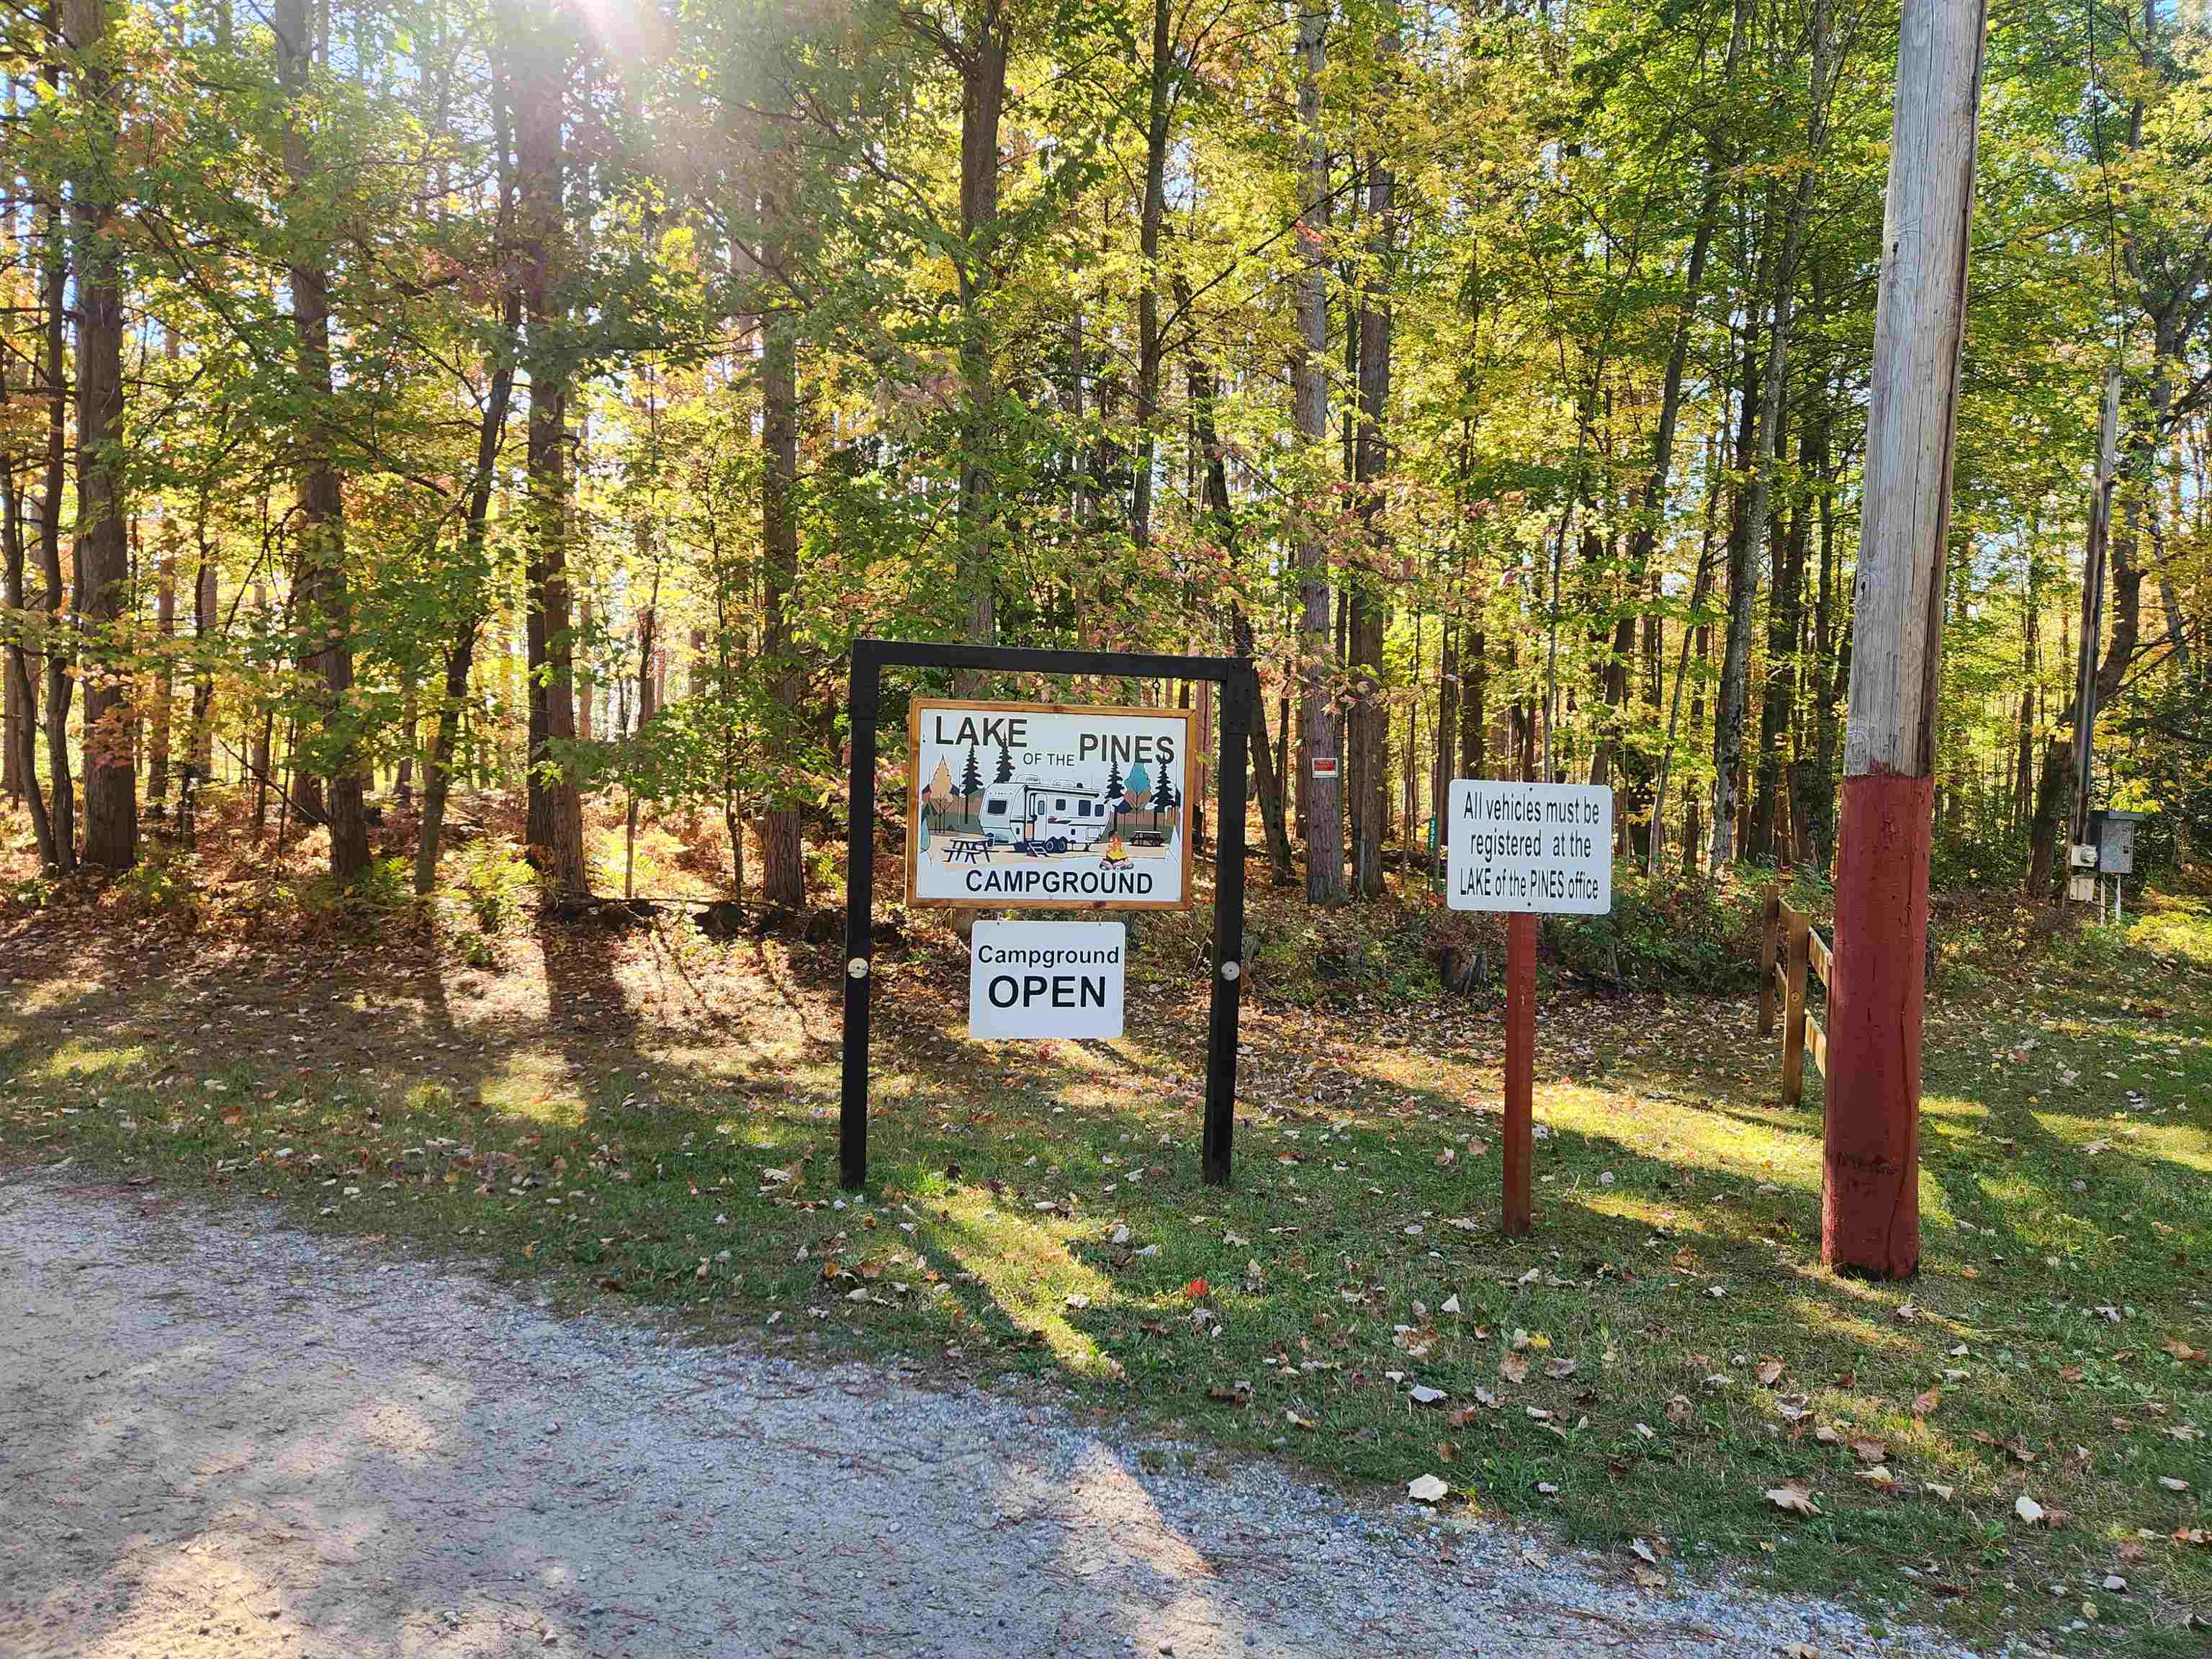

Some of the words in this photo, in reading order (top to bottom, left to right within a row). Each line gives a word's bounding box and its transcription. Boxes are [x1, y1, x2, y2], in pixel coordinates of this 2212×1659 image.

[935, 716, 1028, 748] LAKE
[1022, 752, 1043, 765] OF
[1047, 753, 1075, 767] THE
[1079, 733, 1175, 765] PINES
[1464, 791, 1483, 820] All
[1486, 793, 1542, 822] vehicles
[1547, 800, 1579, 824] must
[1584, 796, 1600, 824] be
[1470, 827, 1542, 863] registered
[1552, 831, 1565, 857] at
[1570, 830, 1591, 858] the
[966, 869, 1153, 894] CAMPGROUND
[1460, 868, 1491, 896] LAKE
[1495, 868, 1507, 896] of
[1509, 869, 1527, 897] the
[1531, 869, 1564, 898] PINES
[1568, 871, 1599, 899] office
[978, 945, 1120, 968] Campground
[989, 975, 1106, 1008] OPEN
